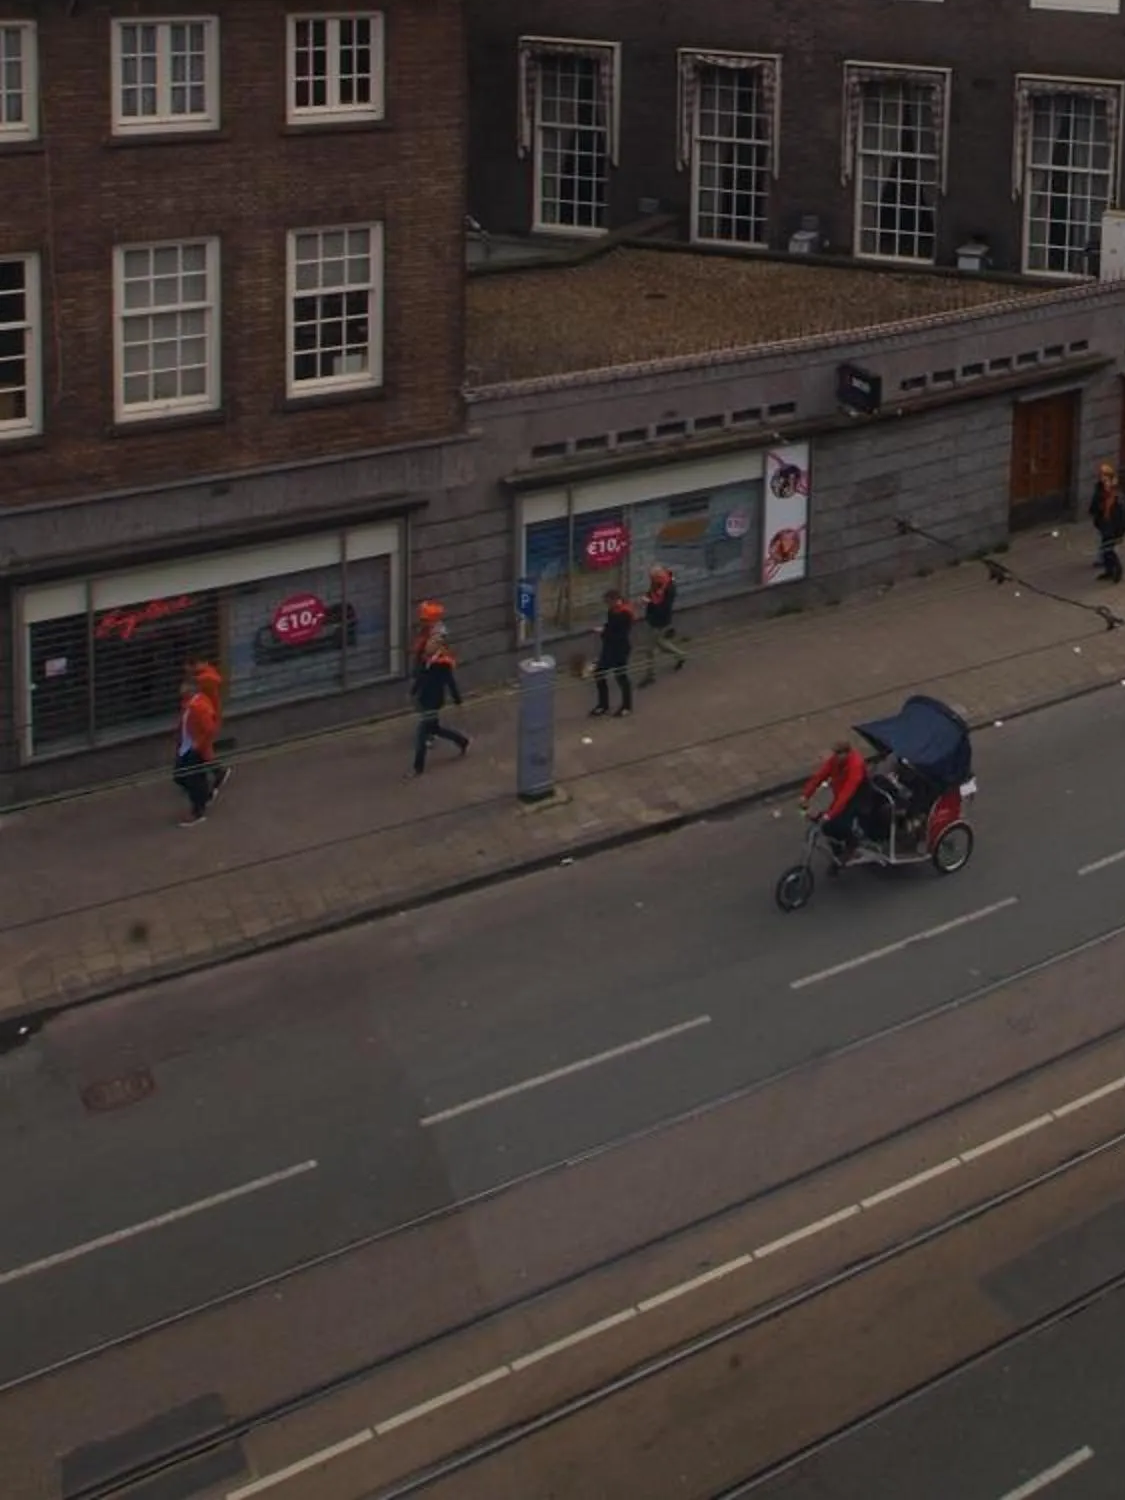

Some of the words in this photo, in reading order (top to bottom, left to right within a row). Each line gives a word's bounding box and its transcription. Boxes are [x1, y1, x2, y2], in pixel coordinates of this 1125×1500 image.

[586, 538, 627, 555] €10,-
[520, 593, 530, 609] P
[276, 610, 325, 632] €10,-
